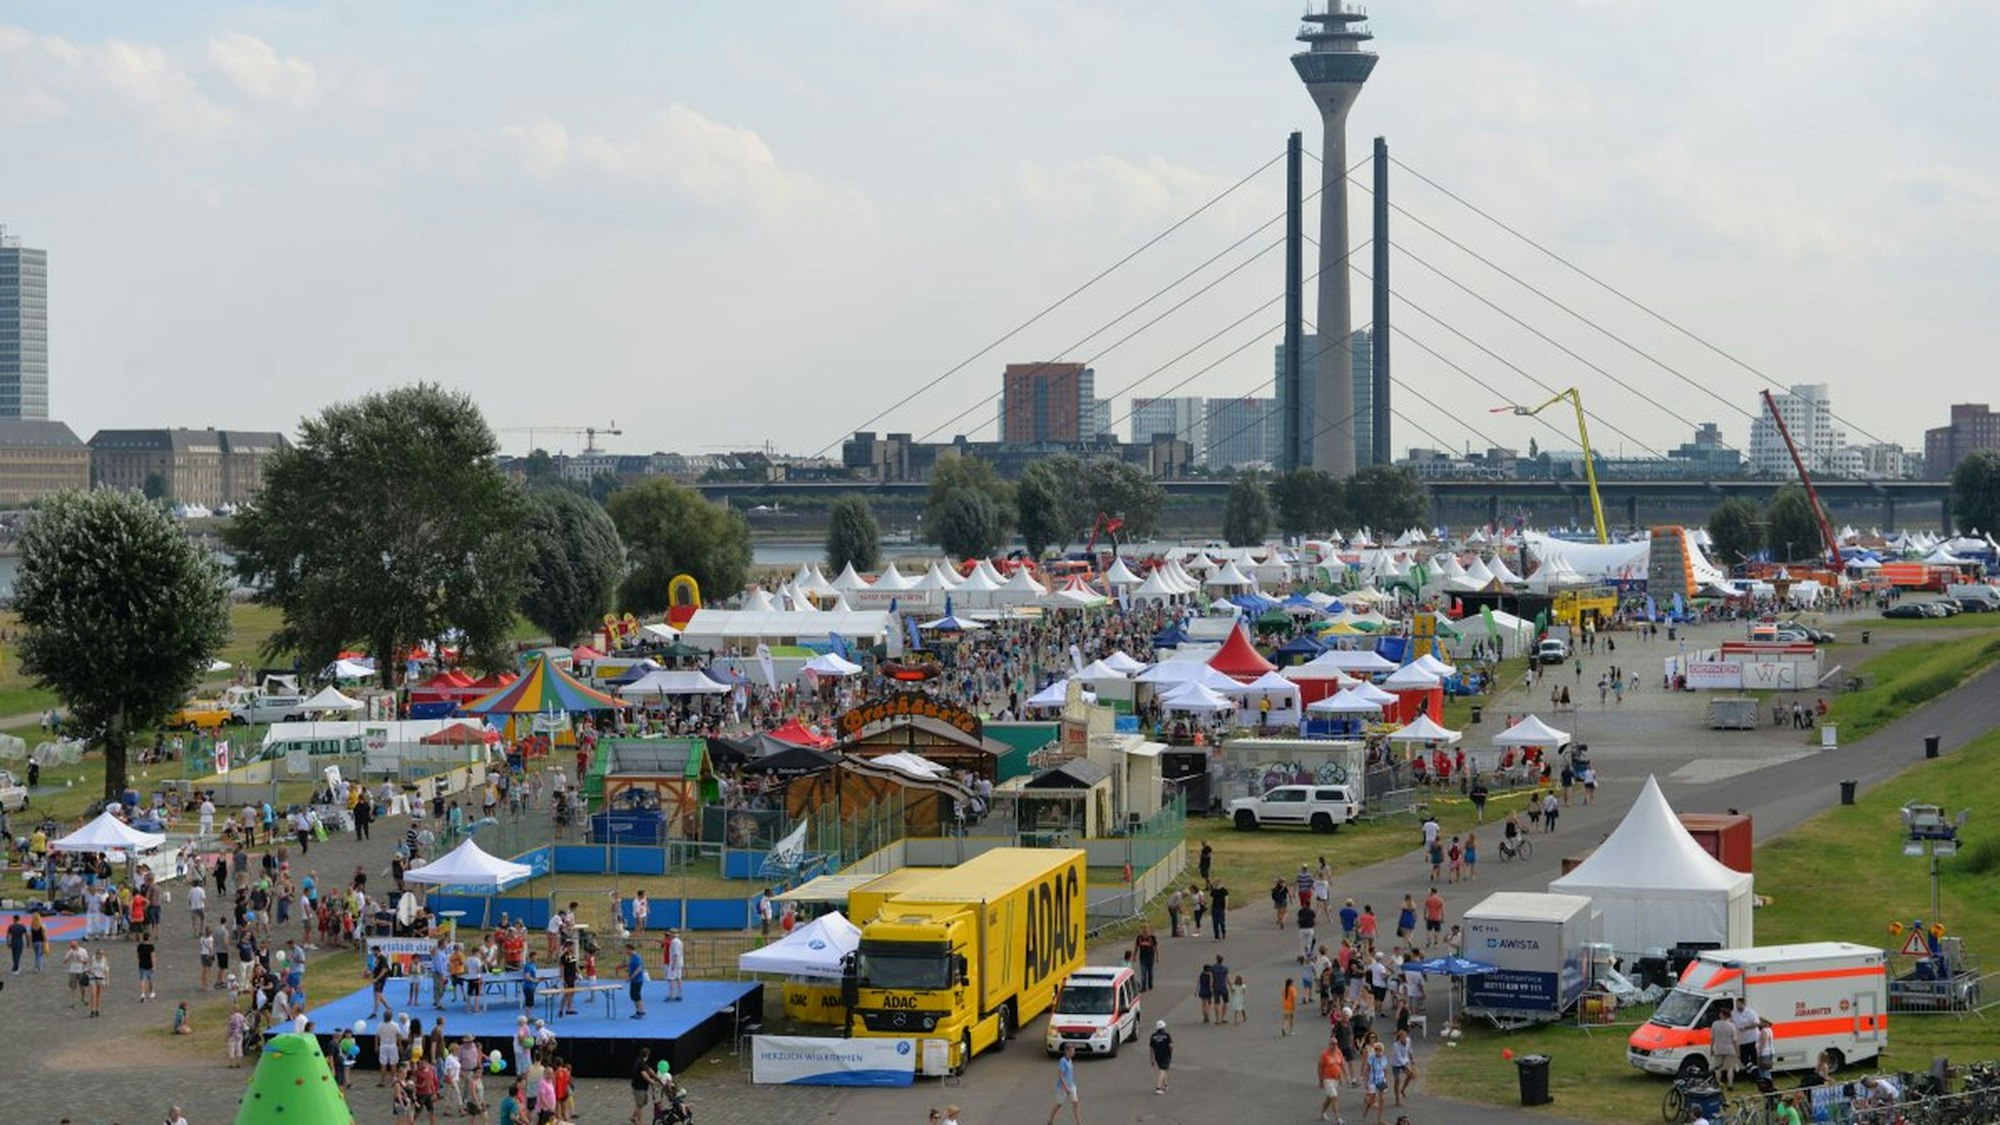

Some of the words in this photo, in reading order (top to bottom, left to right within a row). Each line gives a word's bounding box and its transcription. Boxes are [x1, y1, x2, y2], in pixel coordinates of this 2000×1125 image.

[1755, 667, 1790, 684] WC
[1024, 865, 1079, 991] ADAC
[1499, 938, 1540, 950] AWISTA
[883, 996, 918, 1009] ADAC
[761, 1052, 802, 1061] HERZLICH
[805, 1053, 863, 1063] WILLKOMMEN
